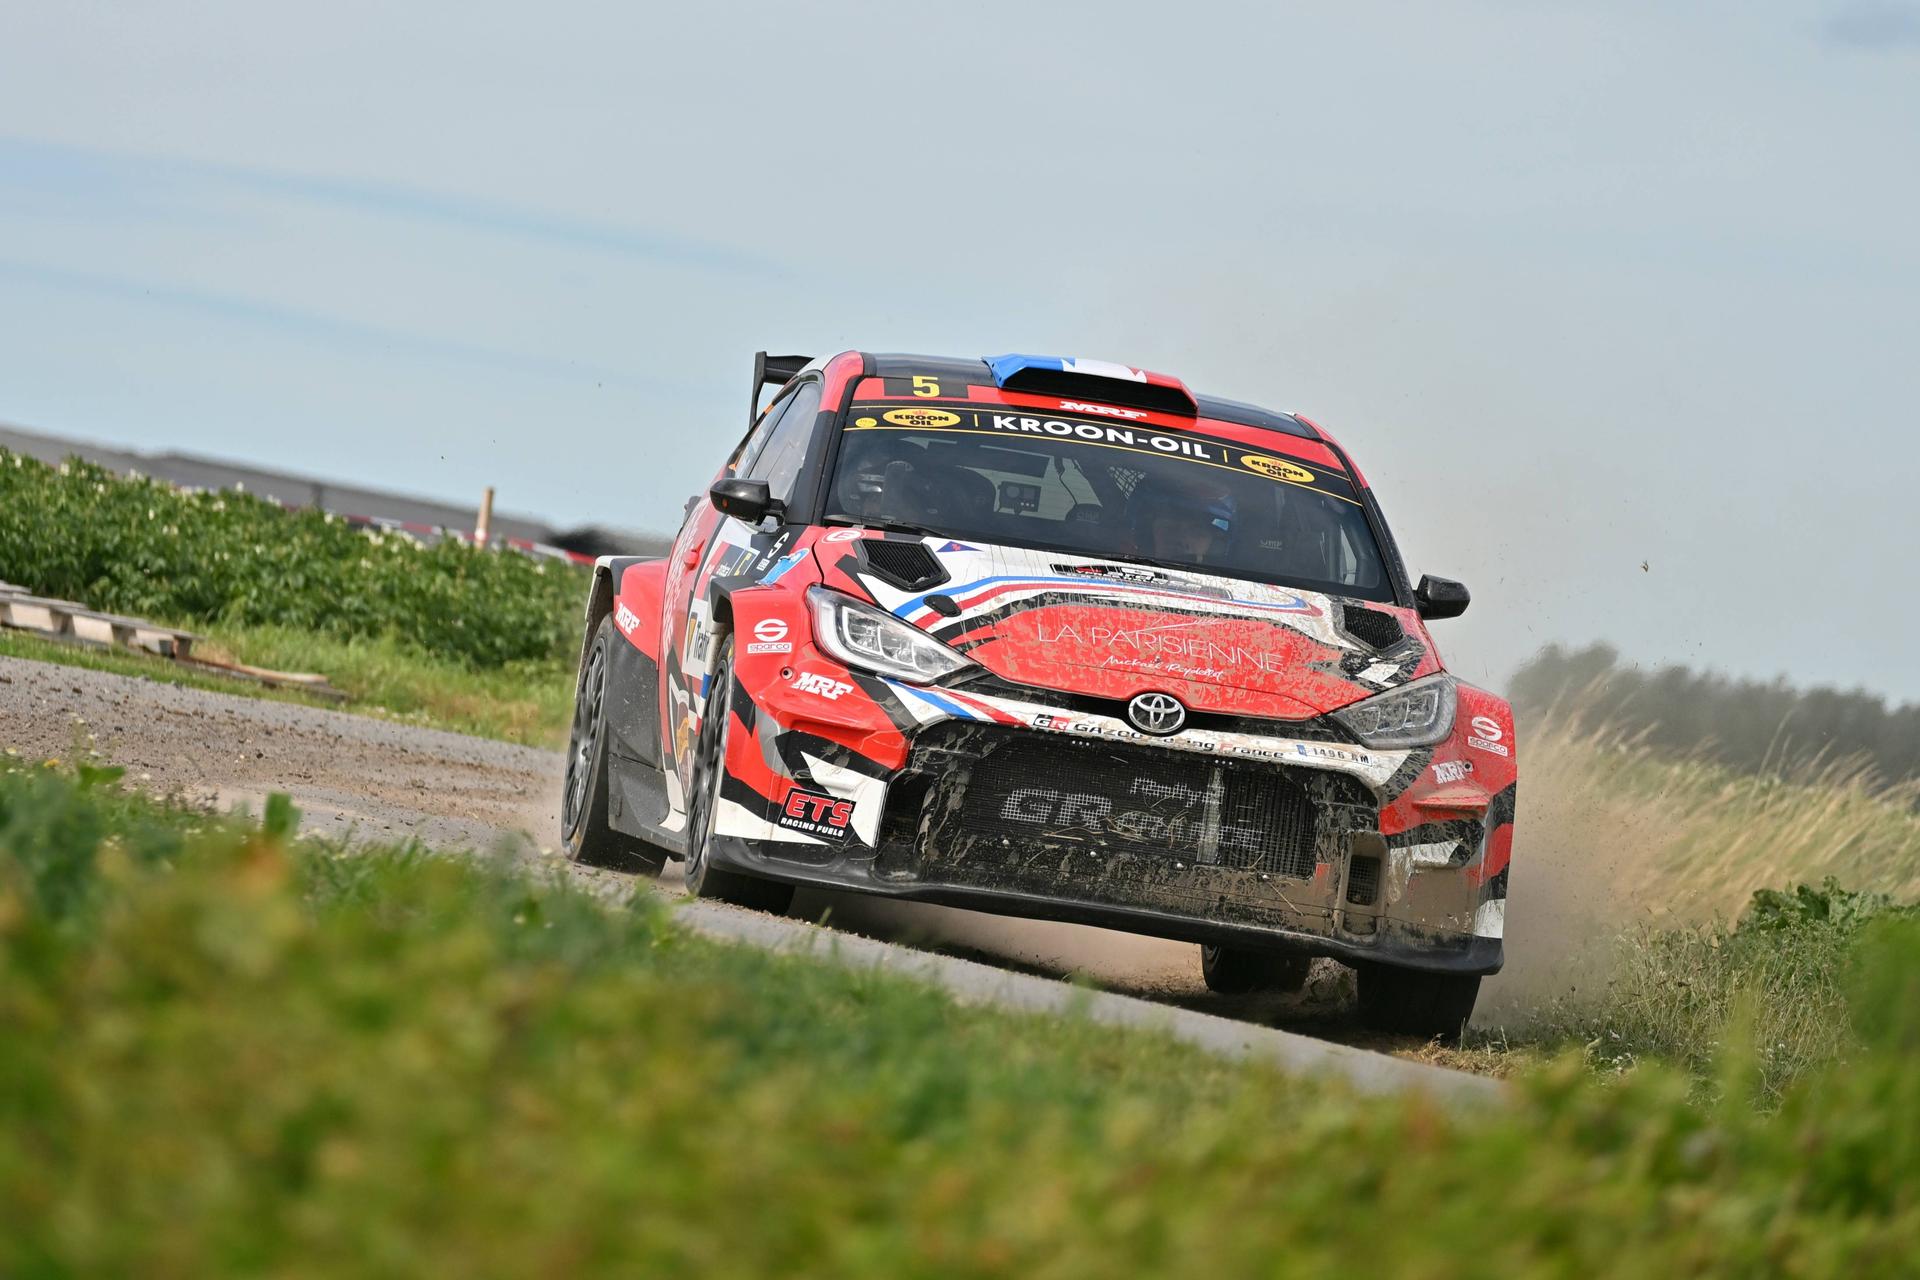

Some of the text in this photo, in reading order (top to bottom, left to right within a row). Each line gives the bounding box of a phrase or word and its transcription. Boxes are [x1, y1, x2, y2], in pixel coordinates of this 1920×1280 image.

[912, 375, 941, 398] 5
[894, 414, 950, 422] KROON
[1059, 400, 1148, 419] MRF
[992, 415, 1211, 459] KROON-OIL
[1250, 459, 1304, 478] KROON
[1266, 468, 1289, 479] OIL
[616, 602, 641, 635] MRF
[749, 643, 791, 653] sparco
[1037, 623, 1286, 676] LA PARISIENNE
[791, 671, 854, 700] MRF
[1033, 714, 1072, 732] GR
[1469, 737, 1507, 755] sparco
[786, 791, 853, 828] ETS
[1000, 786, 1112, 830] GR
[780, 817, 845, 838] RACING FUELS
